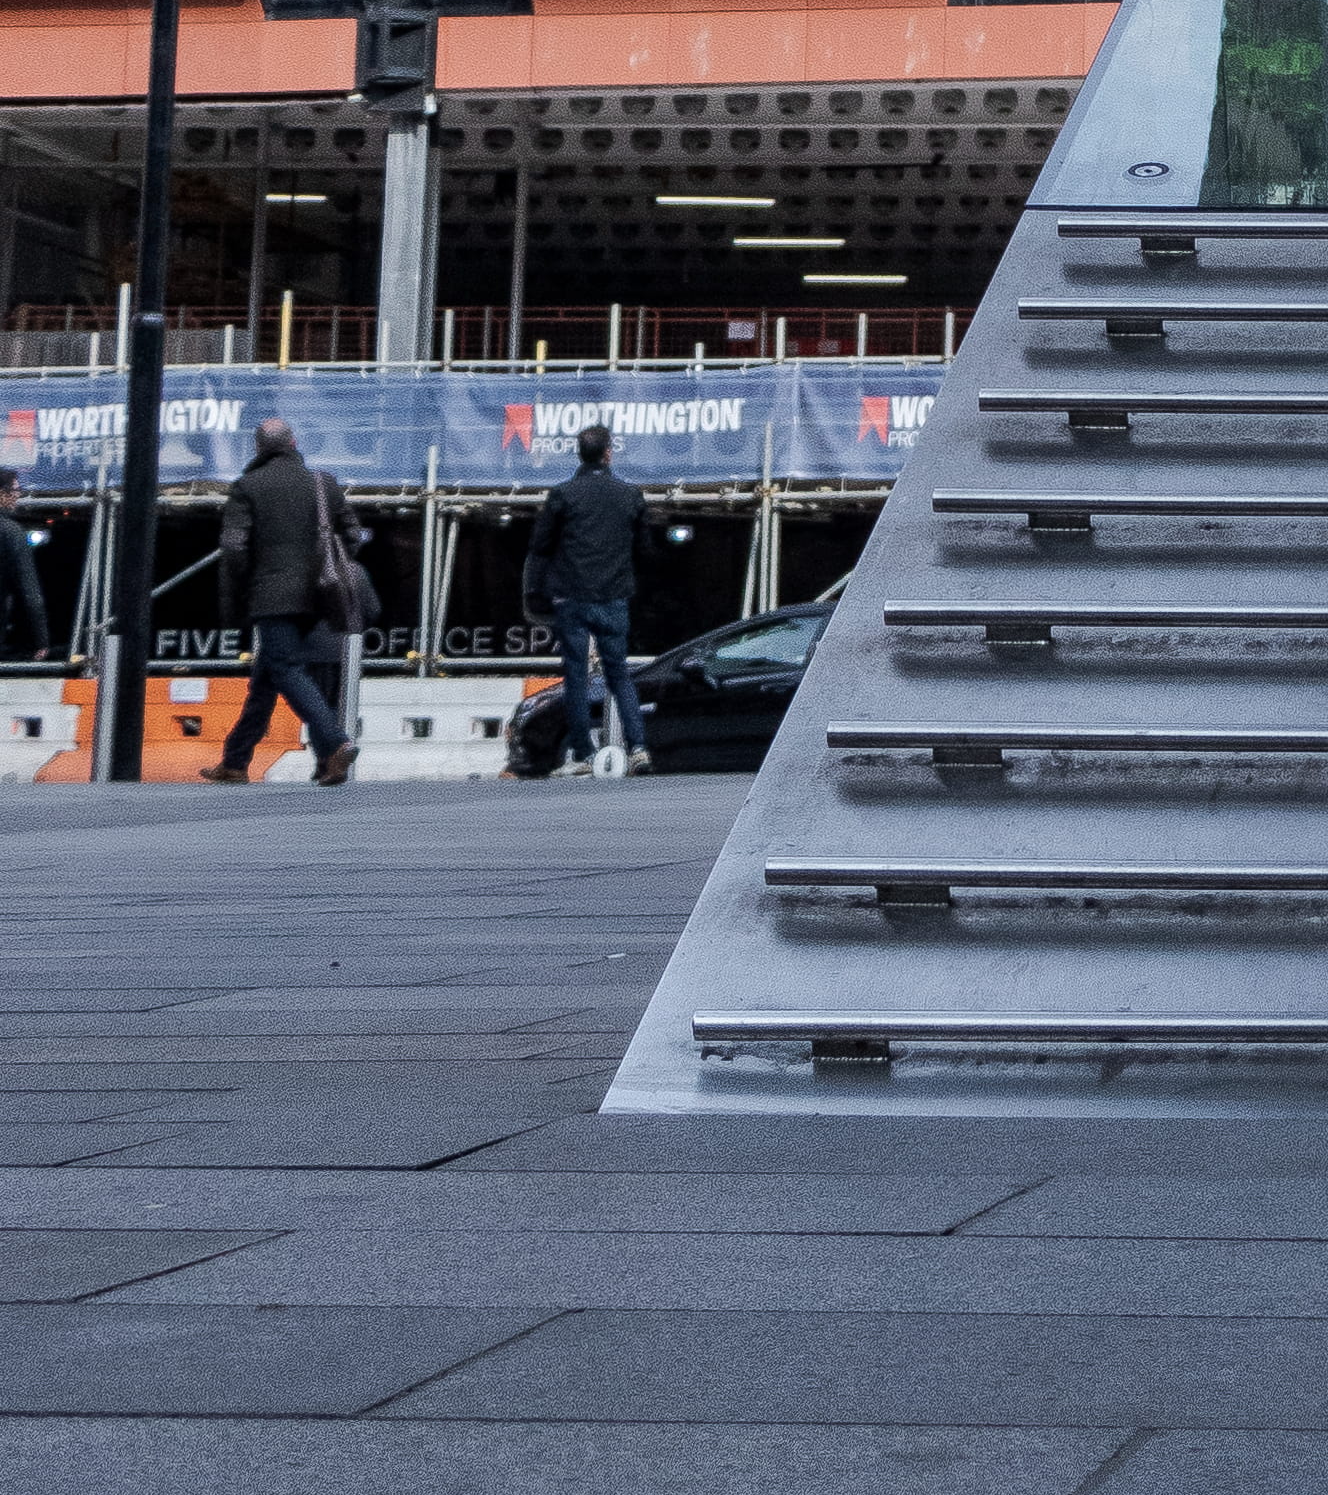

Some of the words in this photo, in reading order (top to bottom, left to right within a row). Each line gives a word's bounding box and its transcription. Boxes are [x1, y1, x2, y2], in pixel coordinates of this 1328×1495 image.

[38, 399, 240, 440] WORTHGTON
[535, 399, 742, 436] WORTHINGTON
[156, 628, 242, 658] FIVE
